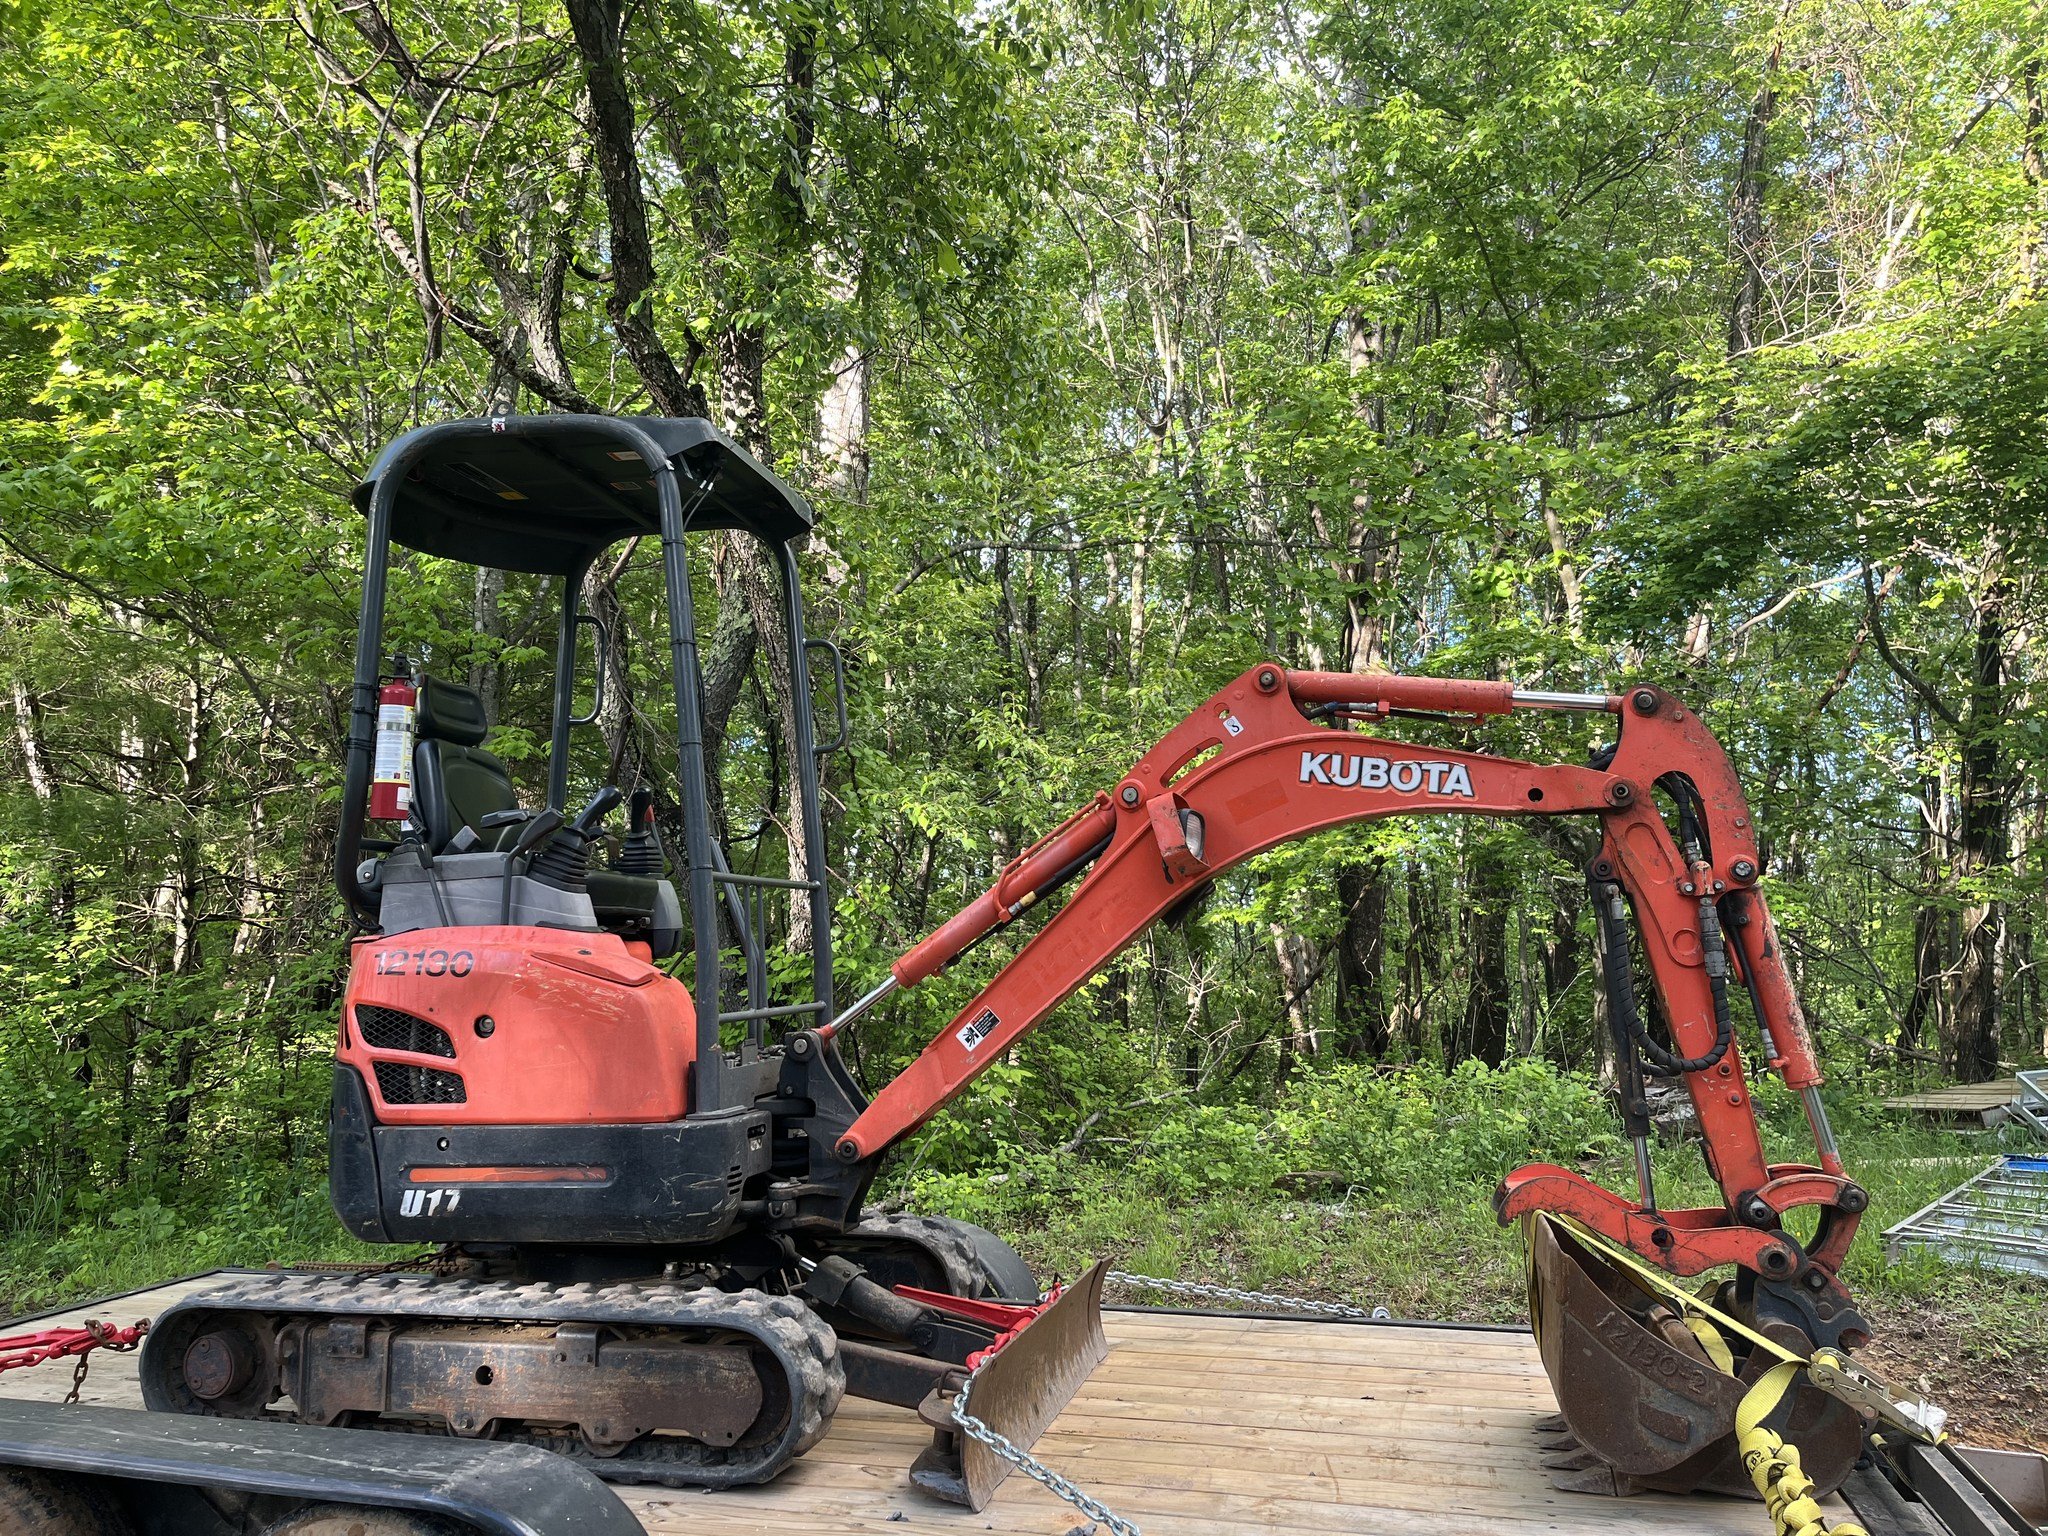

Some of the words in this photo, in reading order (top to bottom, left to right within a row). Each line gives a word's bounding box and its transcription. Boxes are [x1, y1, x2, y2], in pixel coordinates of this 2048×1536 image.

[1299, 751, 1474, 796] KUBOTA
[374, 950, 473, 977] 12130
[399, 1189, 462, 1217] U17
